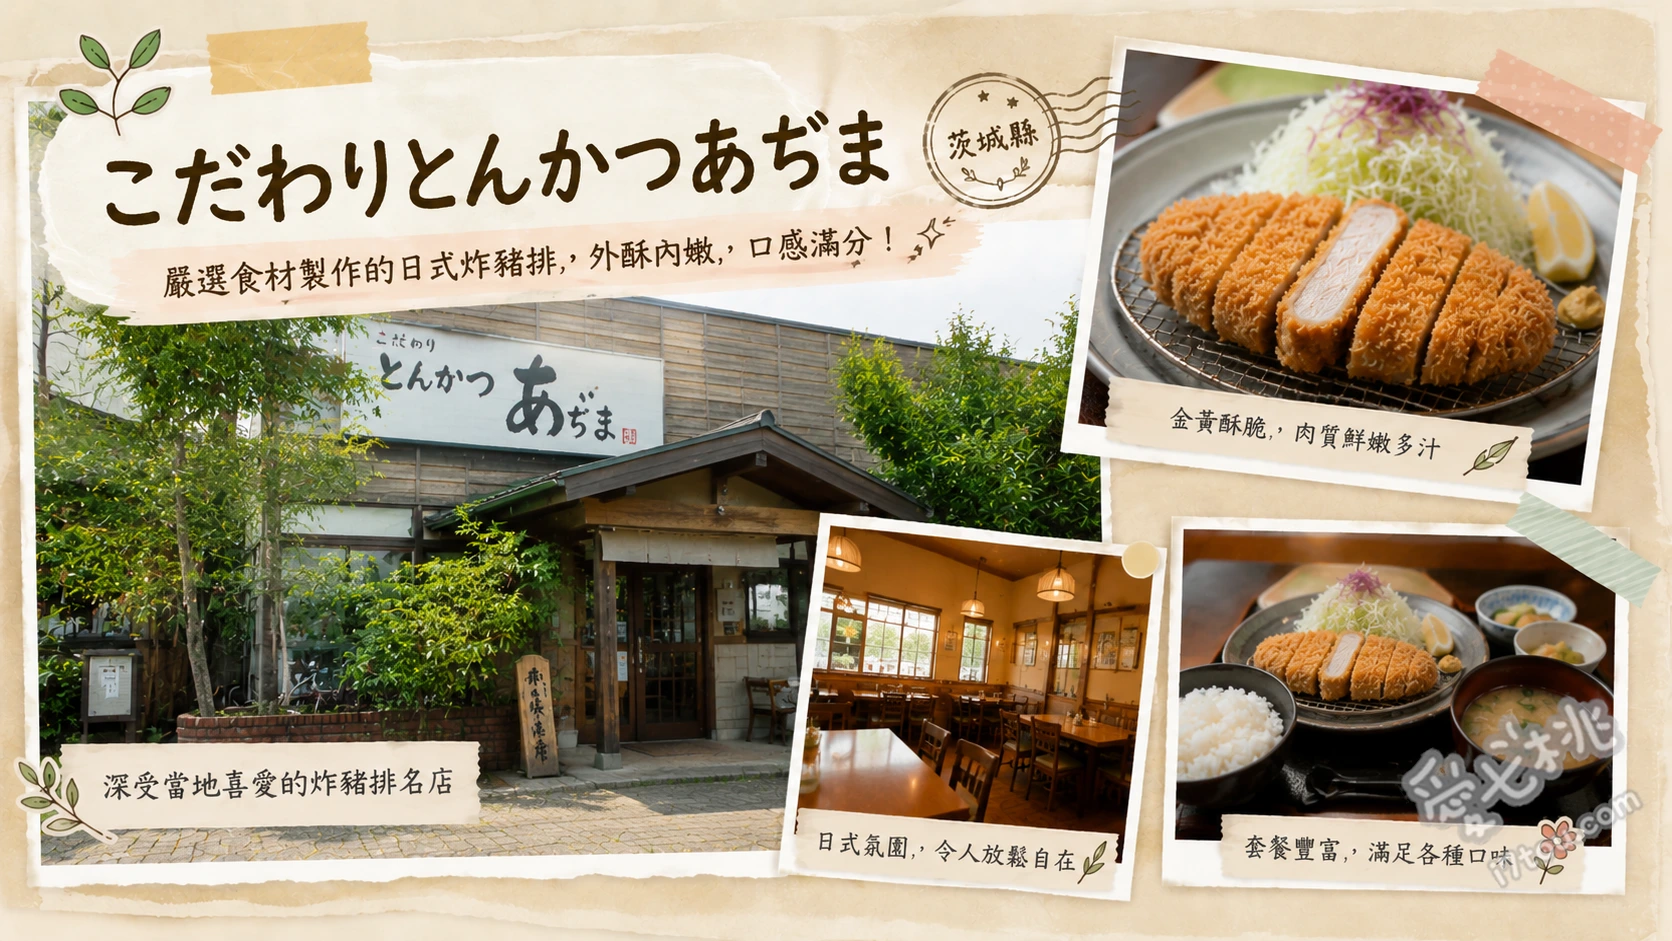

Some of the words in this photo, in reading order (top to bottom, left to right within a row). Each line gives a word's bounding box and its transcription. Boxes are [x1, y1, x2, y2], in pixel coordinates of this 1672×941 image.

[379, 352, 495, 398] とんかつ
[505, 354, 616, 442] あぢま
